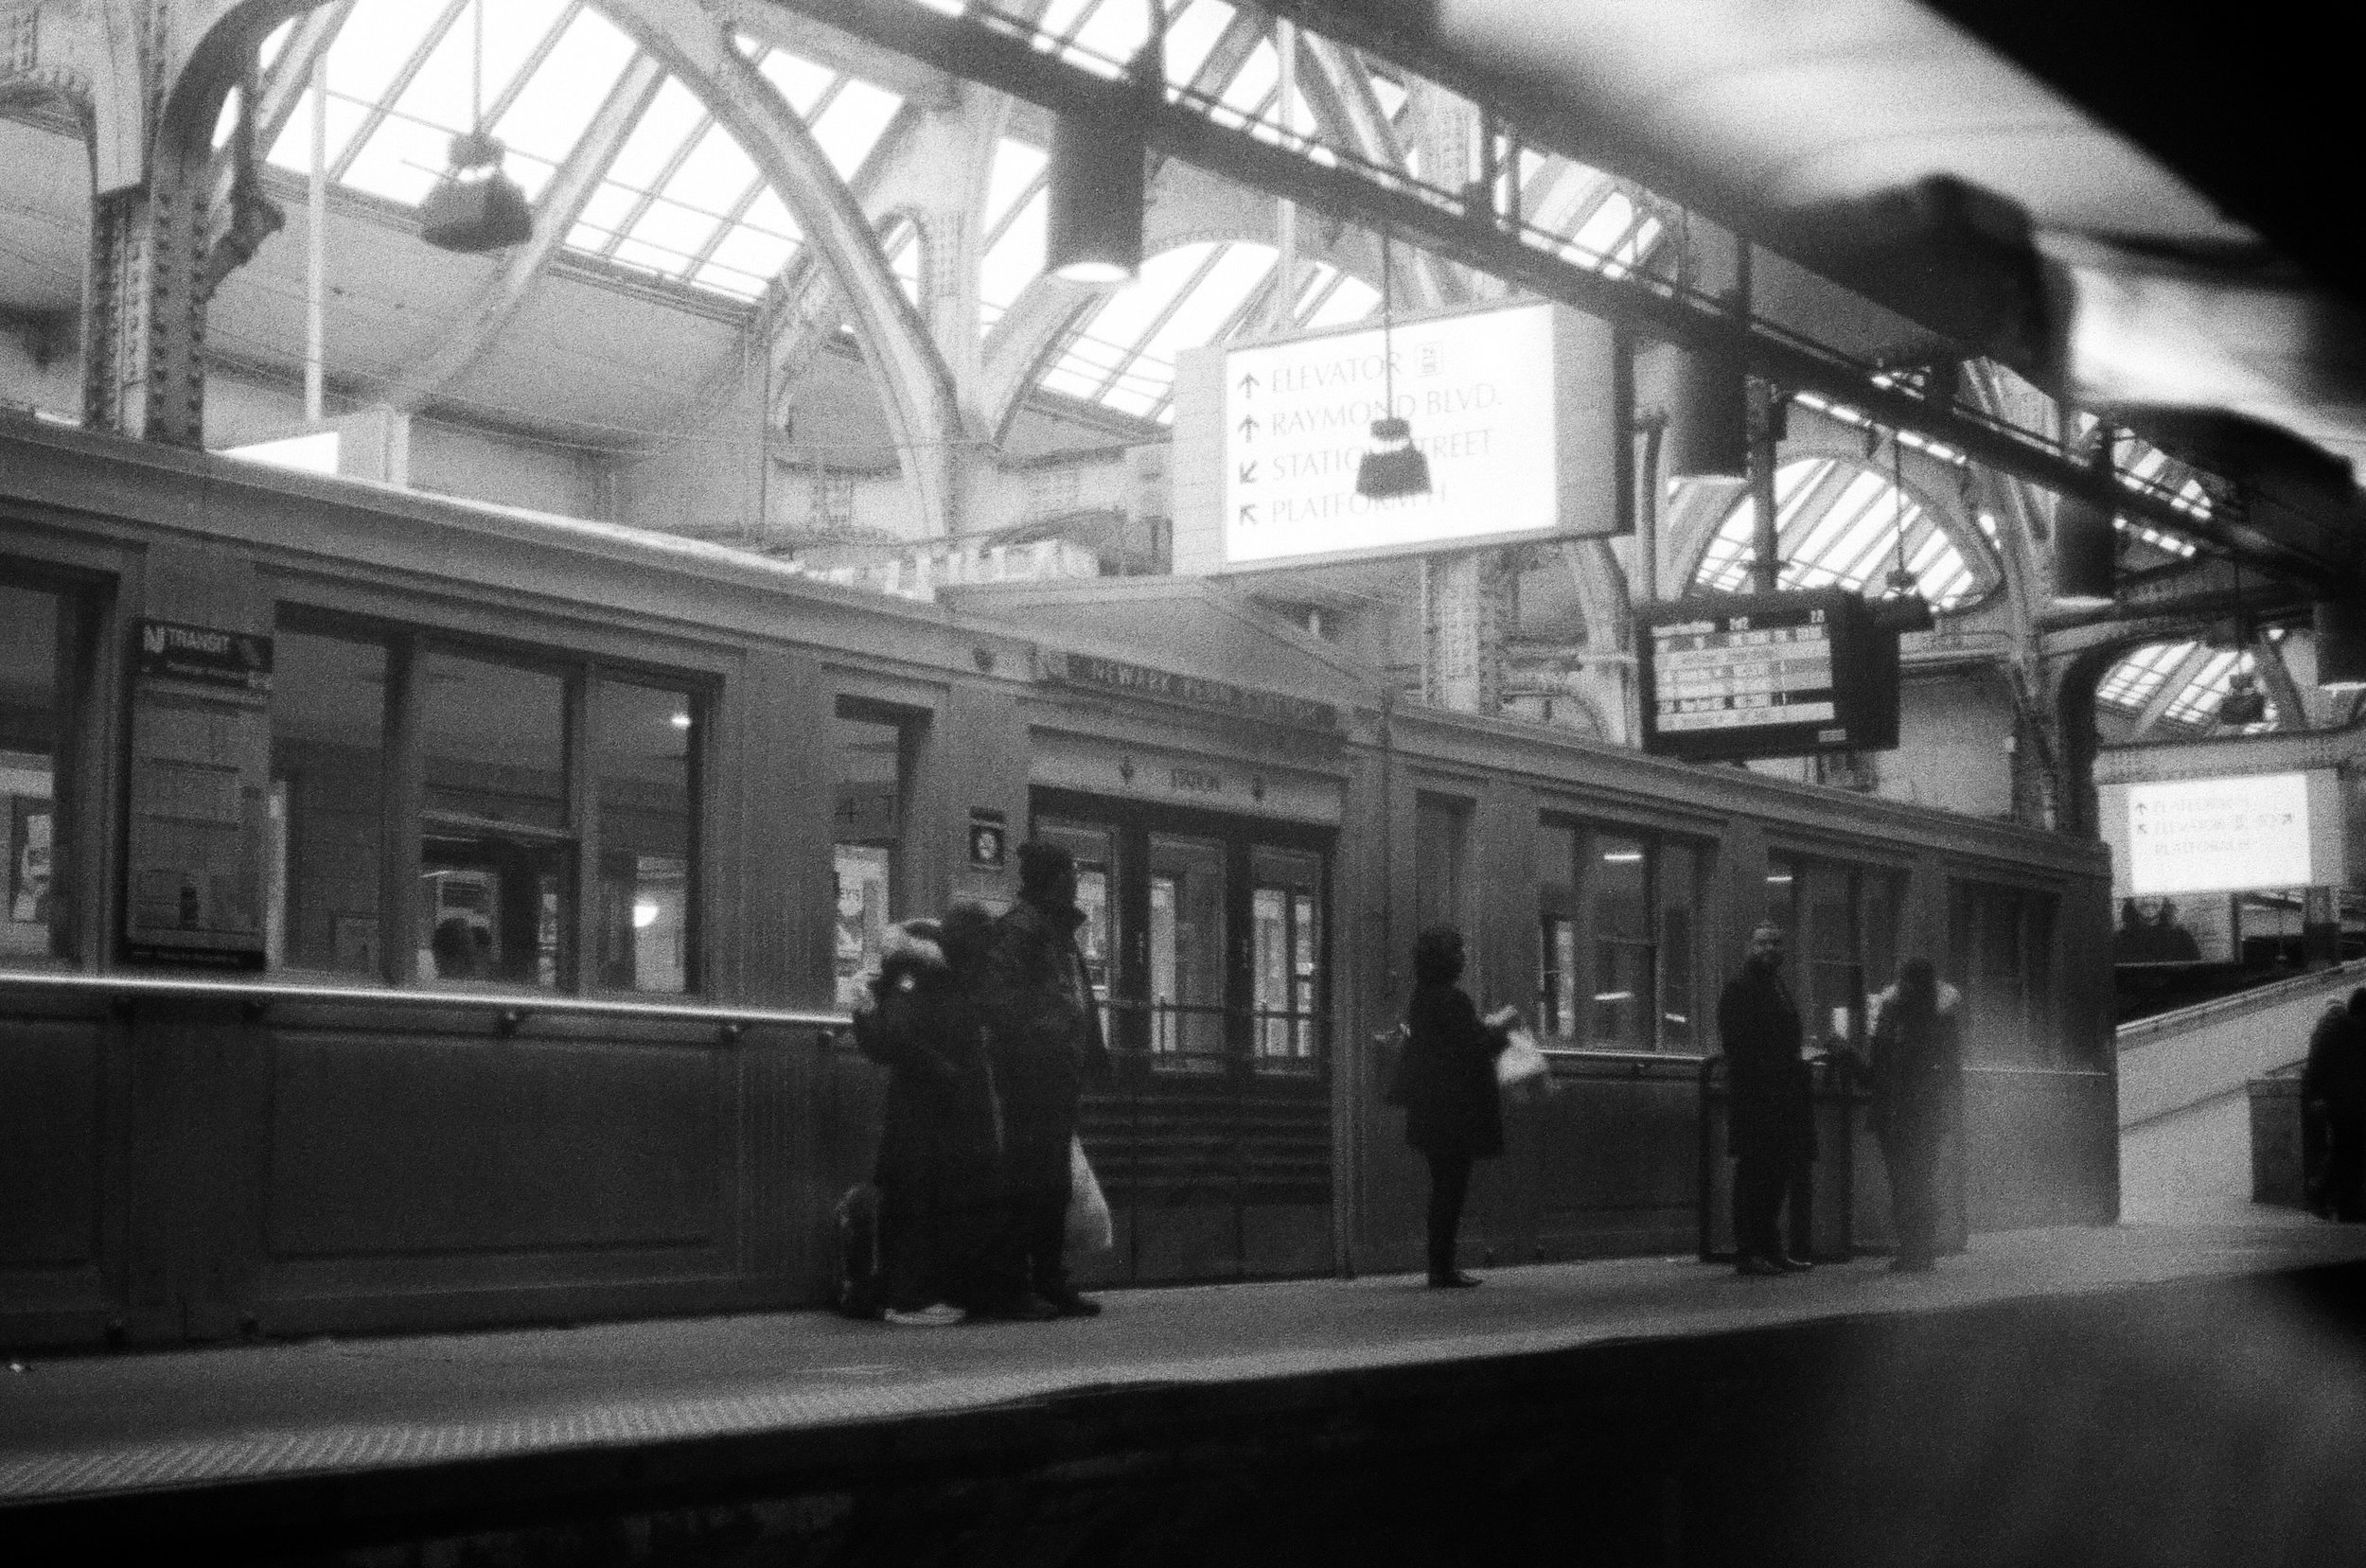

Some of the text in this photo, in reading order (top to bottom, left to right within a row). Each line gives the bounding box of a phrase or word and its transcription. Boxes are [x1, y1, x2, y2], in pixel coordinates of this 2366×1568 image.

[1272, 351, 1404, 394] ELEVATOR
[1272, 382, 1503, 436] RAYMOND BLVD.
[1403, 429, 1493, 463] TREET
[168, 628, 230, 654] TRANSIT
